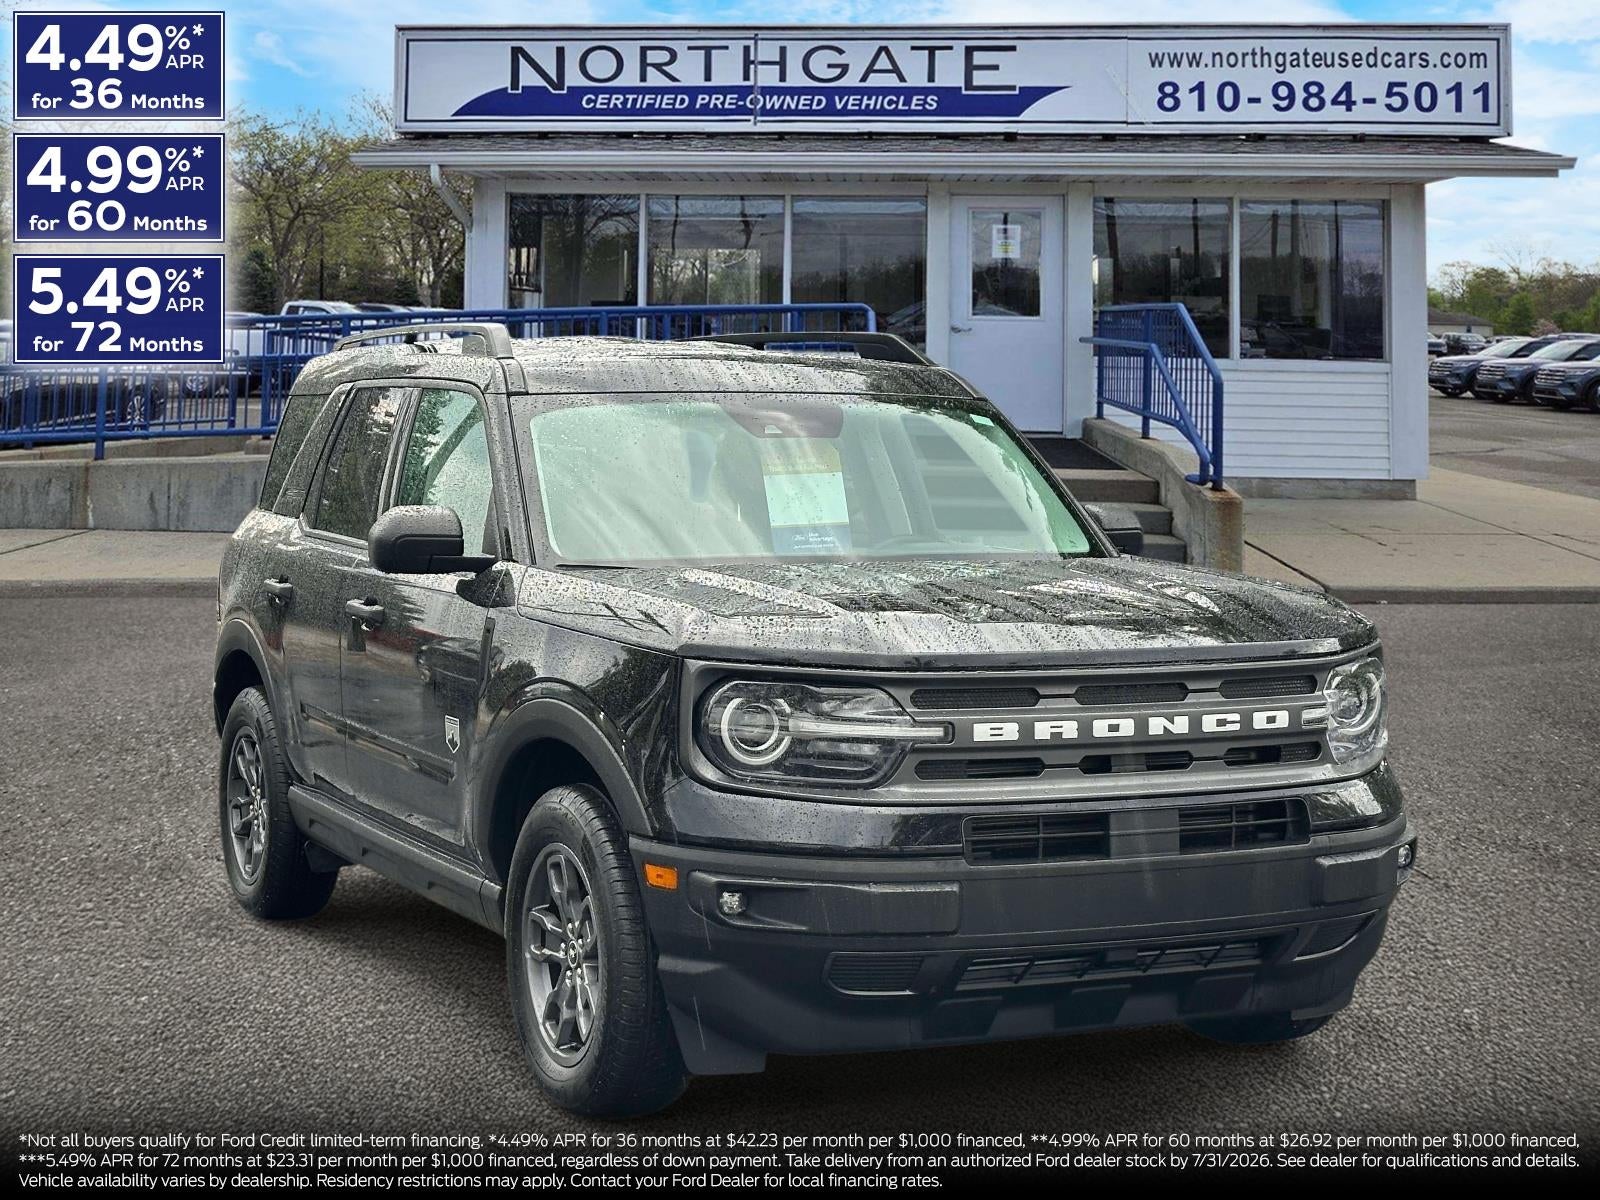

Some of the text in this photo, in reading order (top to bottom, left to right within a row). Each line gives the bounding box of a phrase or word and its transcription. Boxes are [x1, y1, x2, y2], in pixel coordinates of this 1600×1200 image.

[508, 44, 1018, 93] NORTHGATE
[1149, 47, 1487, 73] www.northgateusedcars.com
[581, 93, 938, 111] CERTIFIED PRE-OWNED VEHICLES
[1157, 81, 1490, 113] 810-984-5011
[973, 710, 1289, 742] BRONCO
